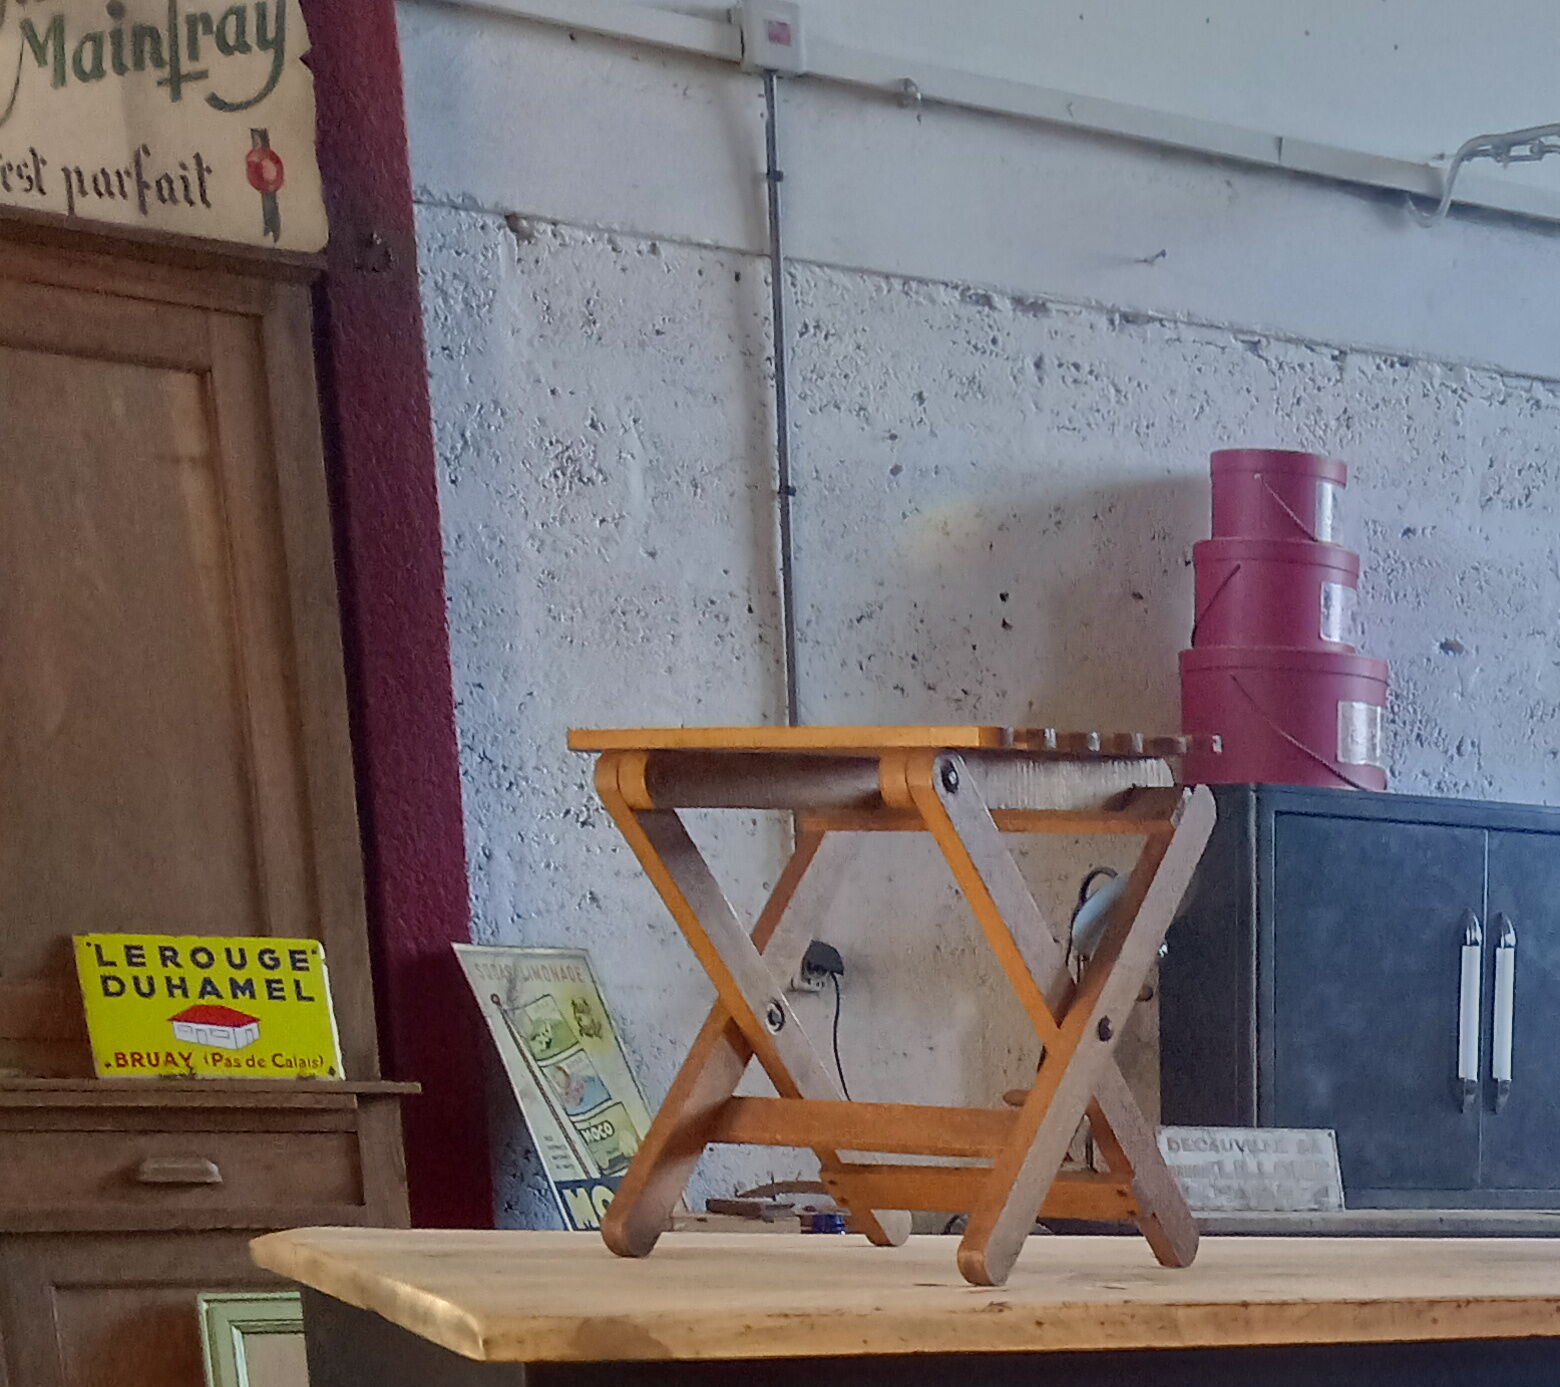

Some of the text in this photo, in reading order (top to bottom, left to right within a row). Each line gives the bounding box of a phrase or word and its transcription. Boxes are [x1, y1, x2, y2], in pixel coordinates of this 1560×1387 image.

[20, 0, 286, 112] Mainfray
[61, 143, 213, 217] parfait
[94, 943, 311, 972] LEROUGE
[100, 974, 315, 1002] DUHAMEL
[114, 1051, 324, 1069] BRUAY (Pas de Calais)
